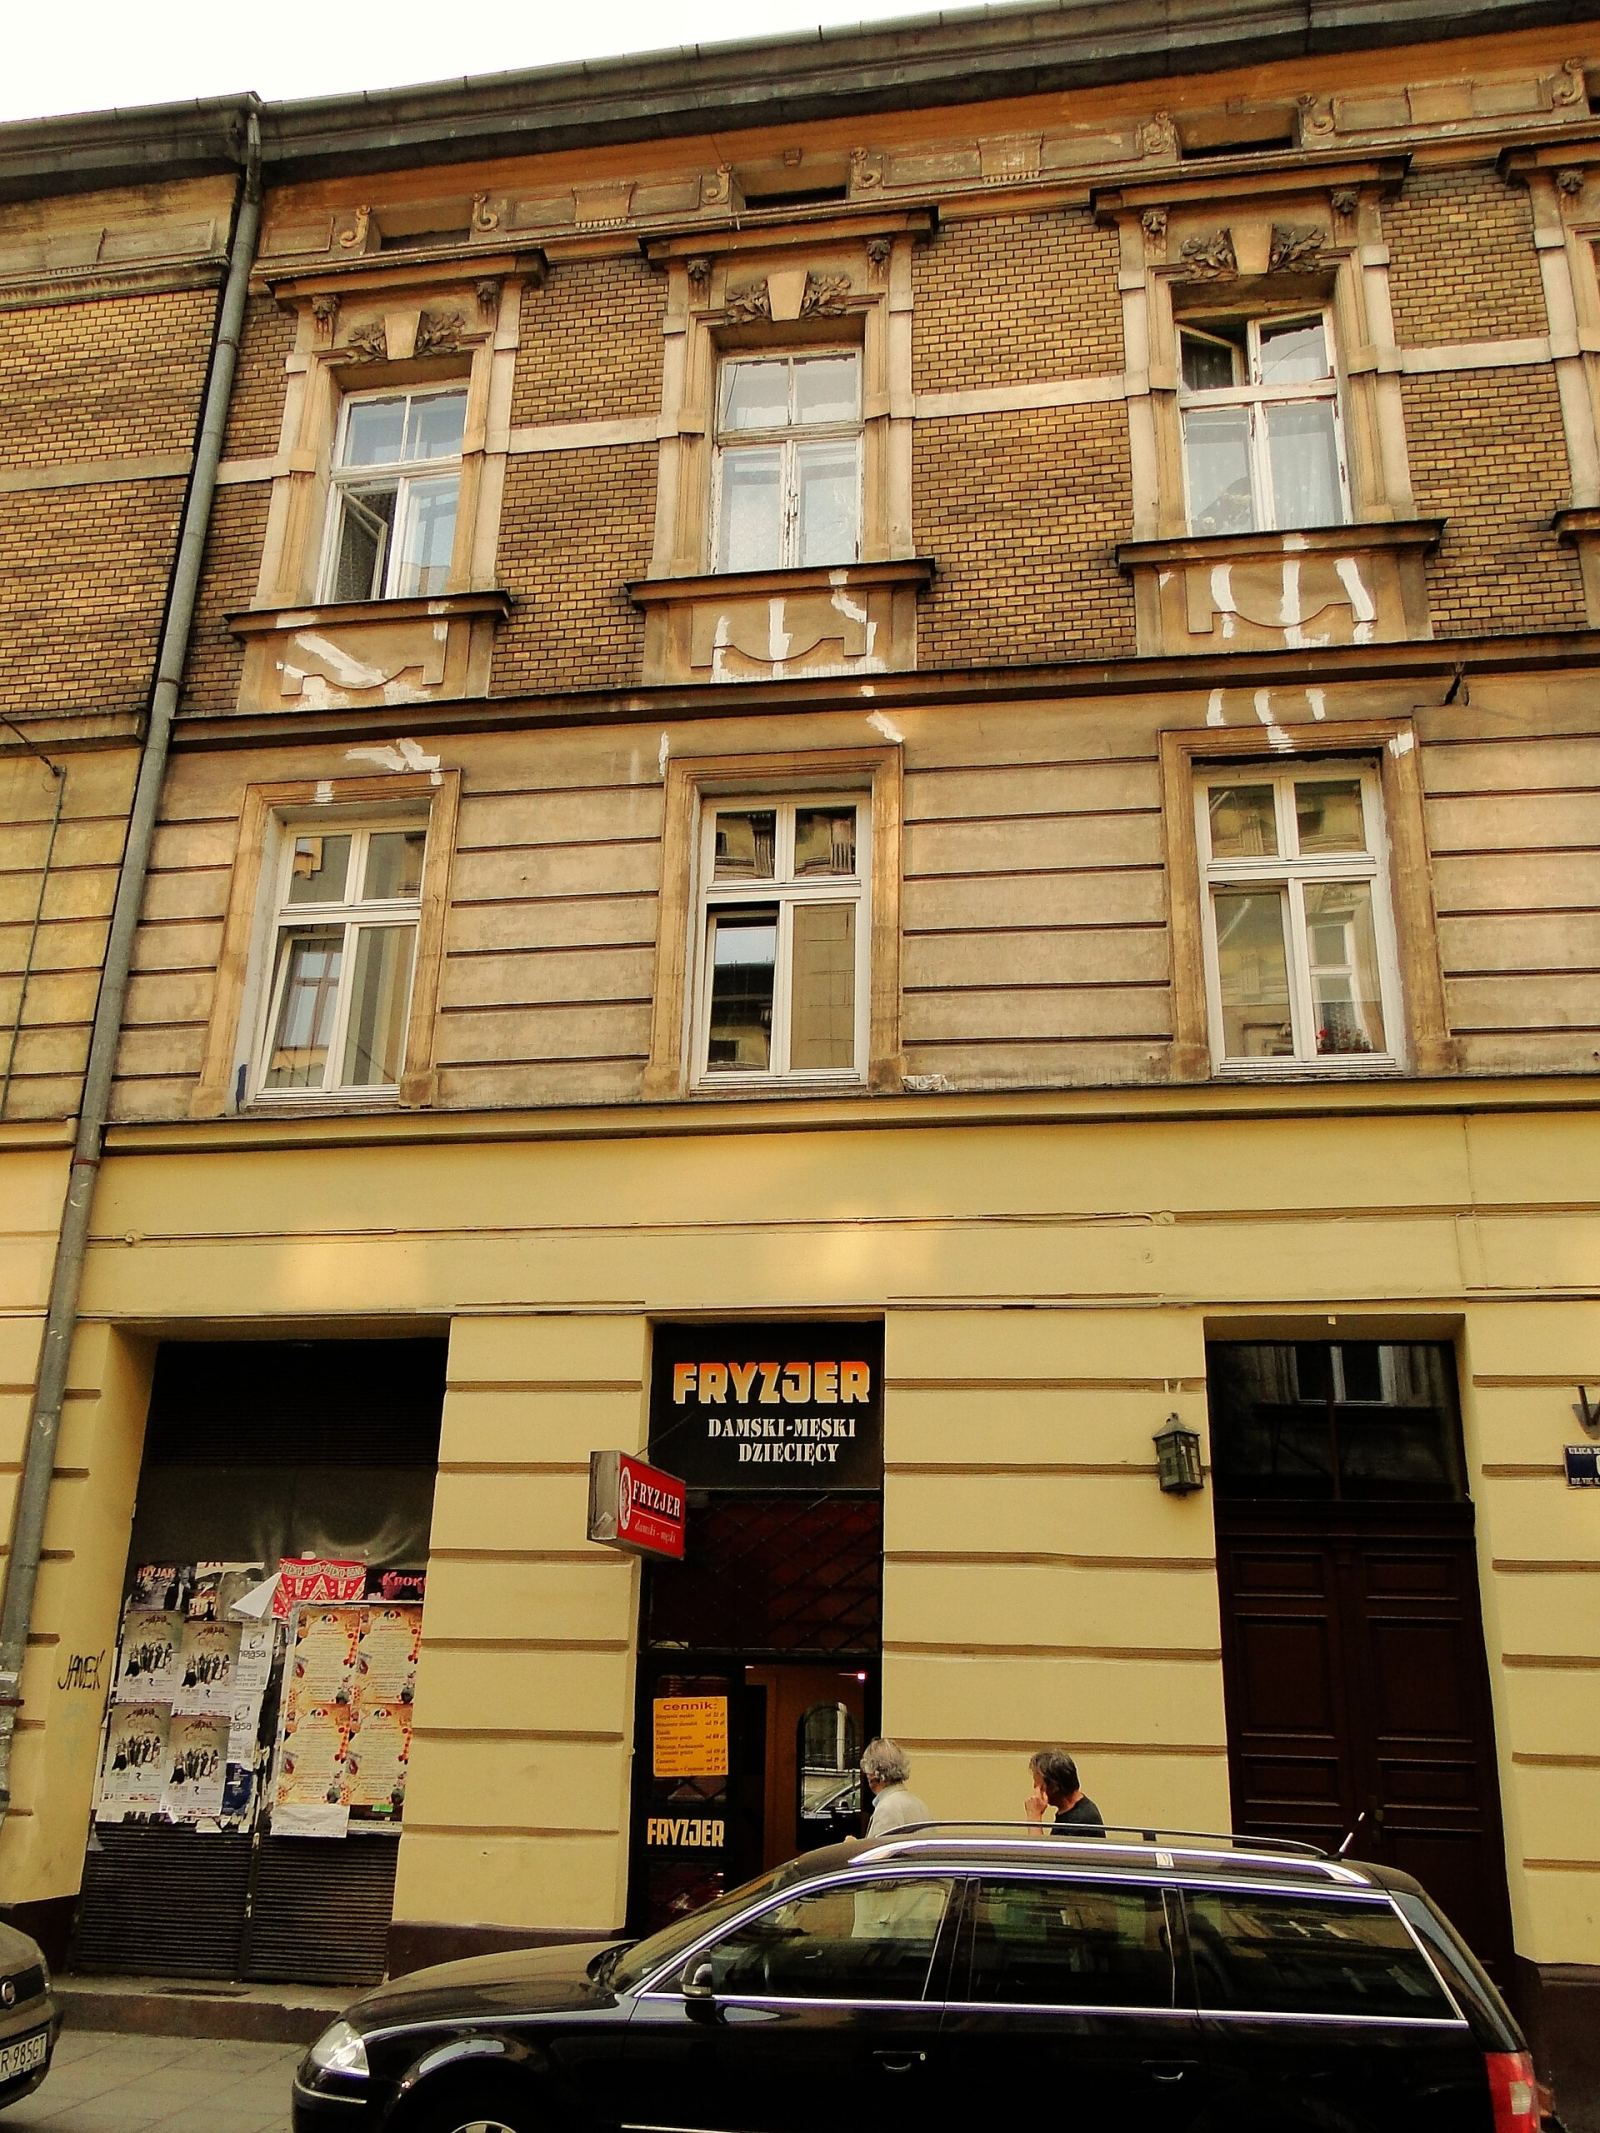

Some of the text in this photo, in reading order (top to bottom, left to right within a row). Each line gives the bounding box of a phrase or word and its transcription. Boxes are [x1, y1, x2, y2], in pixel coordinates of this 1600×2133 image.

[673, 1361, 870, 1404] FRYZJER
[708, 1418, 856, 1442] DAMSKI-MĘSKI
[738, 1443, 839, 1466] DZIECIĘCY
[632, 1480, 681, 1517] FRYZJER
[663, 1702, 718, 1711] cennik:
[647, 1818, 725, 1847] FRYZJER
[0, 2050, 9, 2073] R
